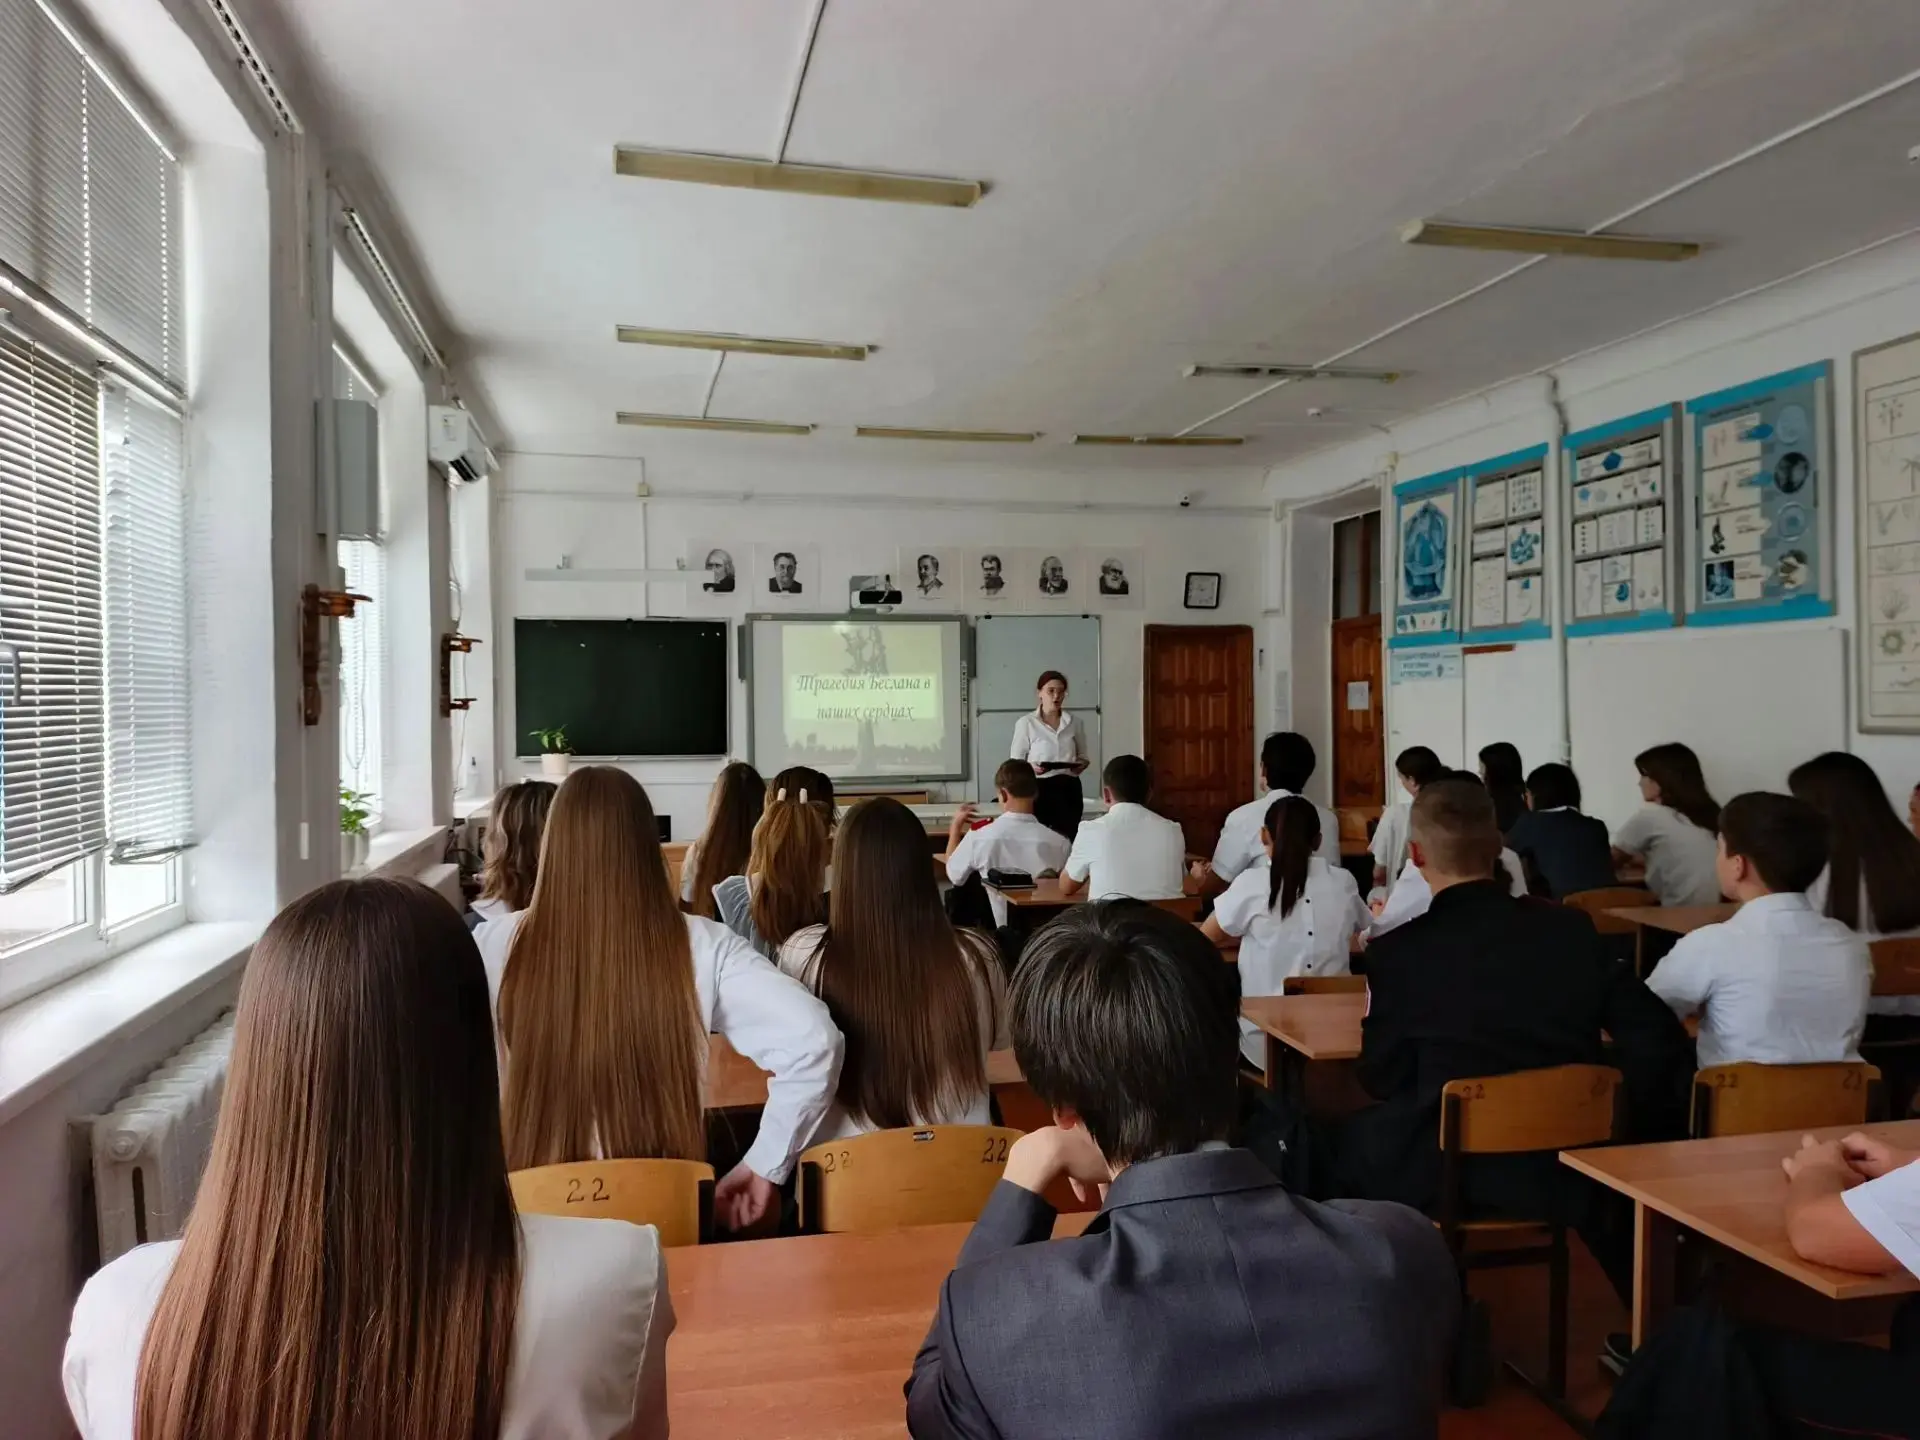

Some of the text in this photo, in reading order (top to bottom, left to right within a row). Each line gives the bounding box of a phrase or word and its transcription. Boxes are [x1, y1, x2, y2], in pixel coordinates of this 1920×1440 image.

[798, 674, 865, 695] Трагедия
[922, 678, 931, 690] в
[817, 702, 915, 723] наших сердцах
[982, 1137, 1007, 1164] 22
[566, 1177, 610, 1204] 22
